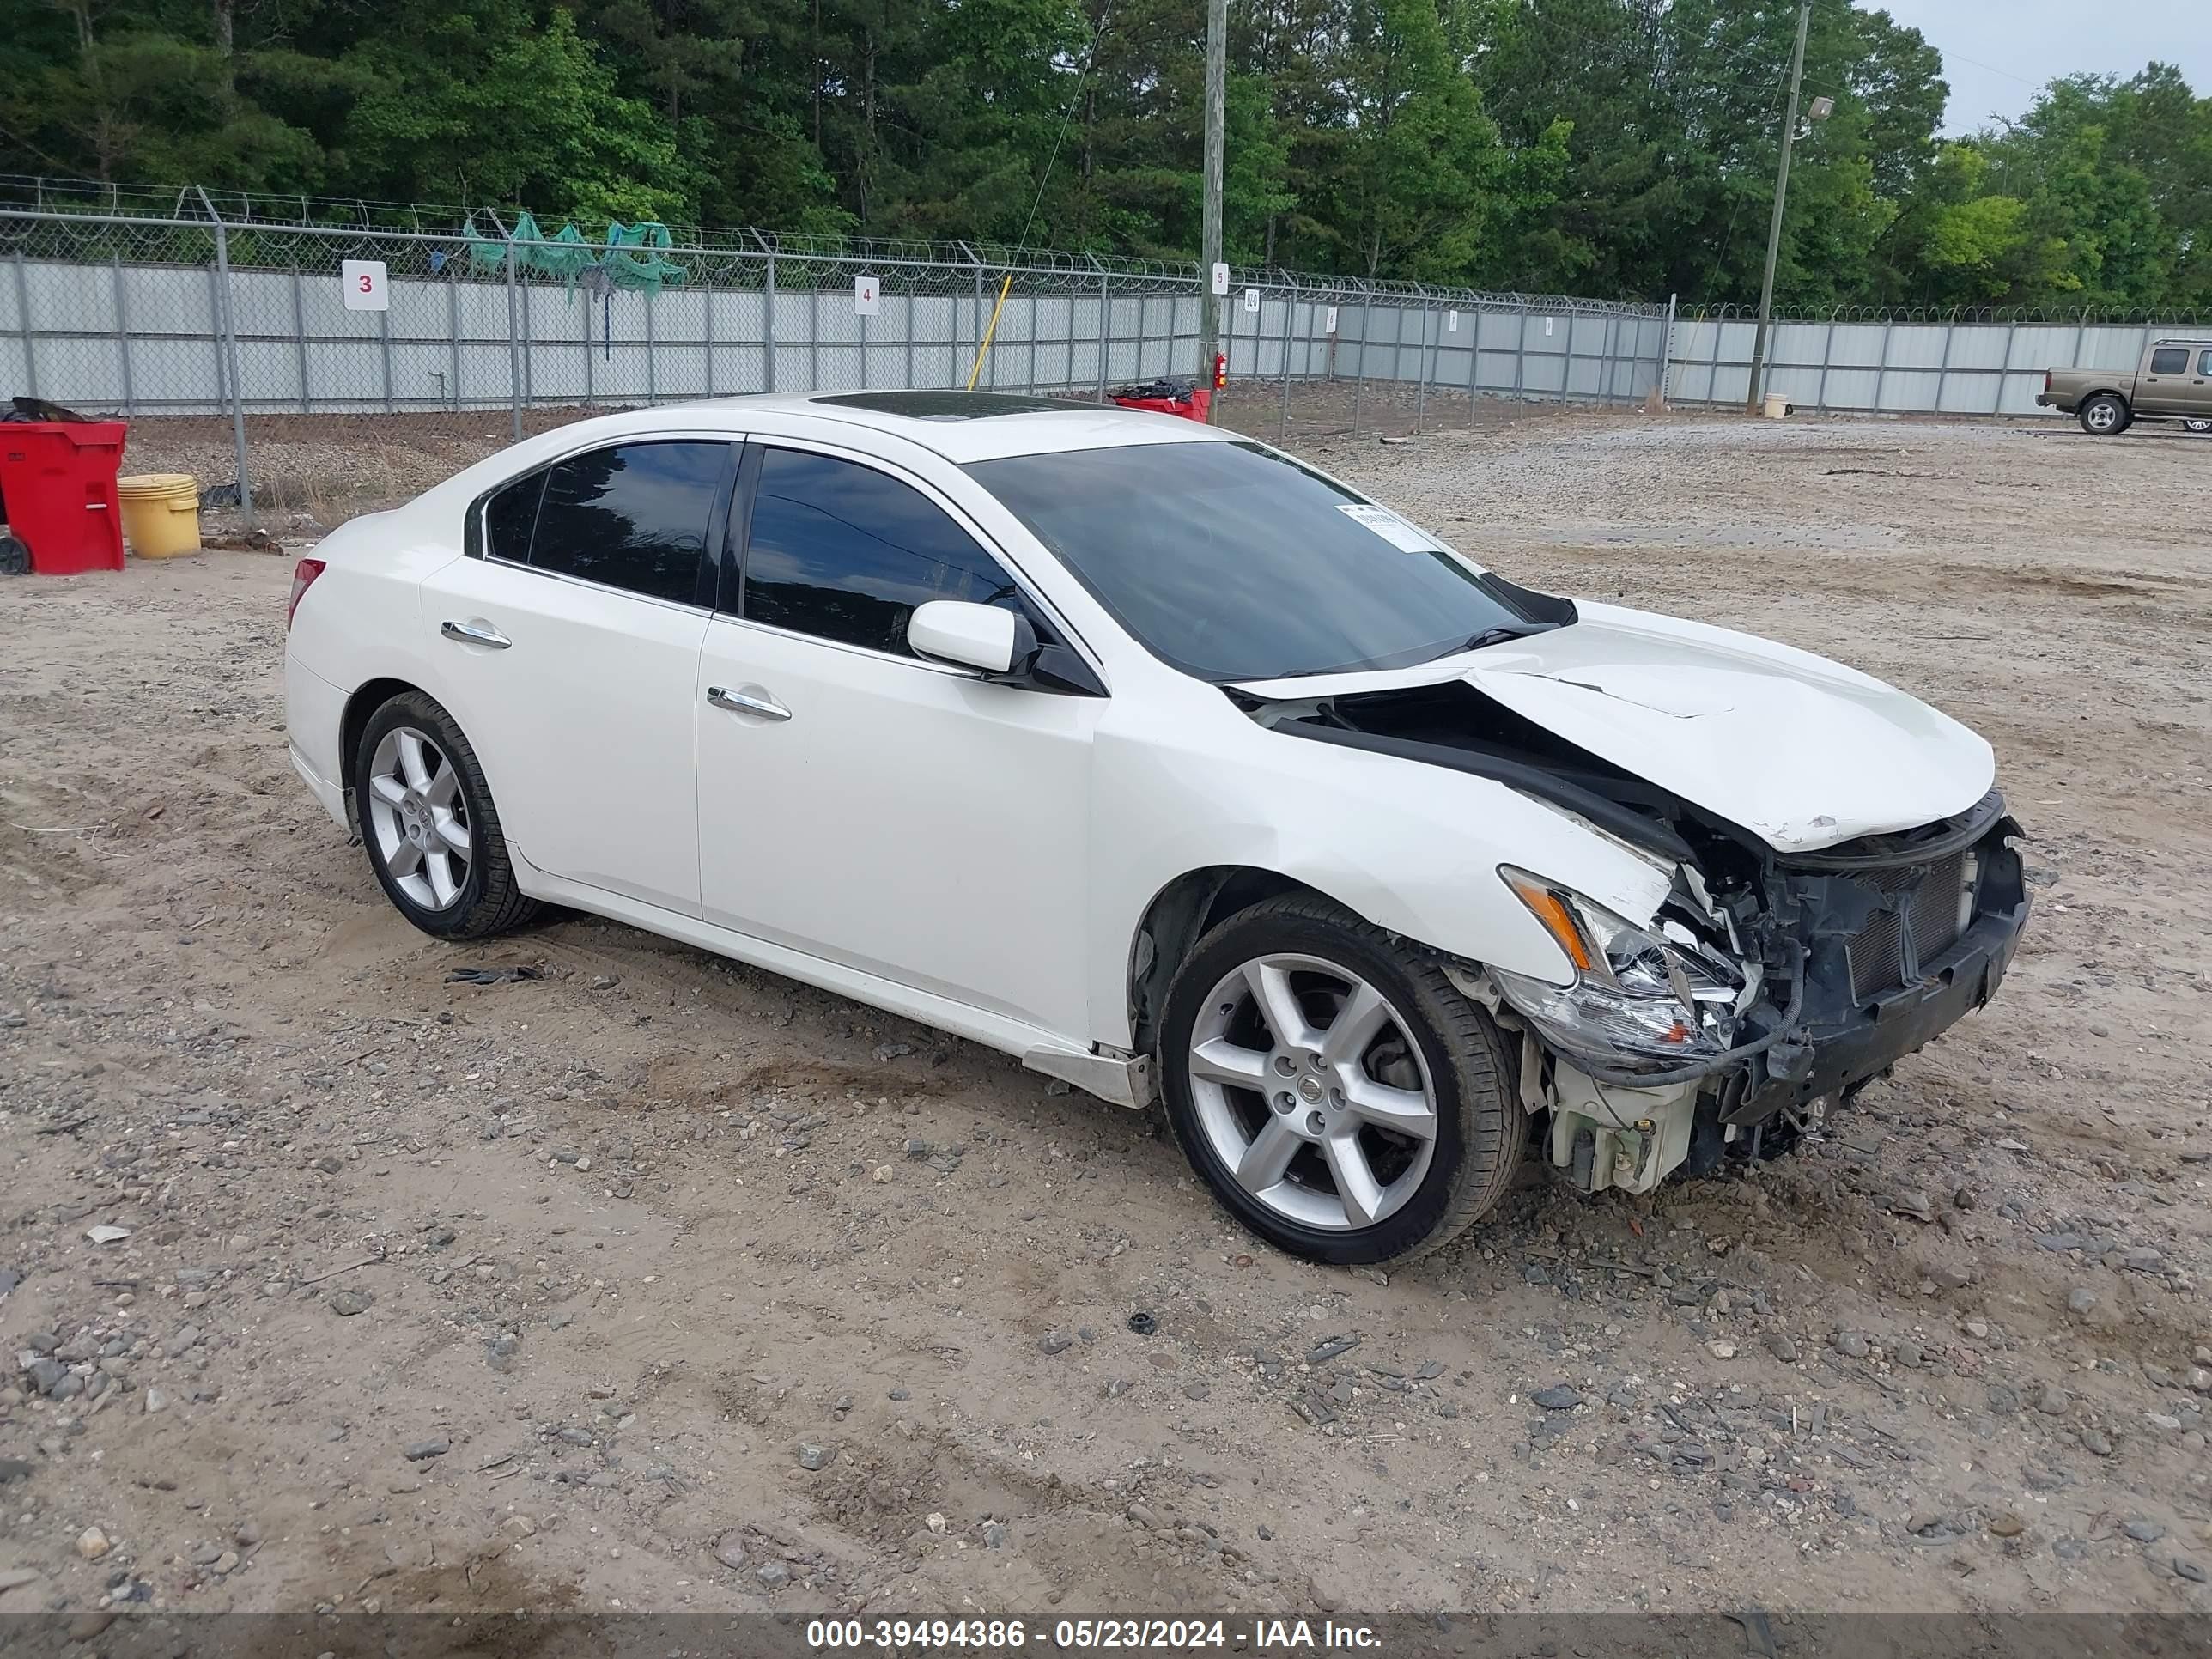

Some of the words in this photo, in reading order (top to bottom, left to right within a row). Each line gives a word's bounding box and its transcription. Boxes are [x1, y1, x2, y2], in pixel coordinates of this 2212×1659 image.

[359, 275, 372, 292] 3
[1218, 272, 1223, 283] 5
[863, 289, 872, 301] 4
